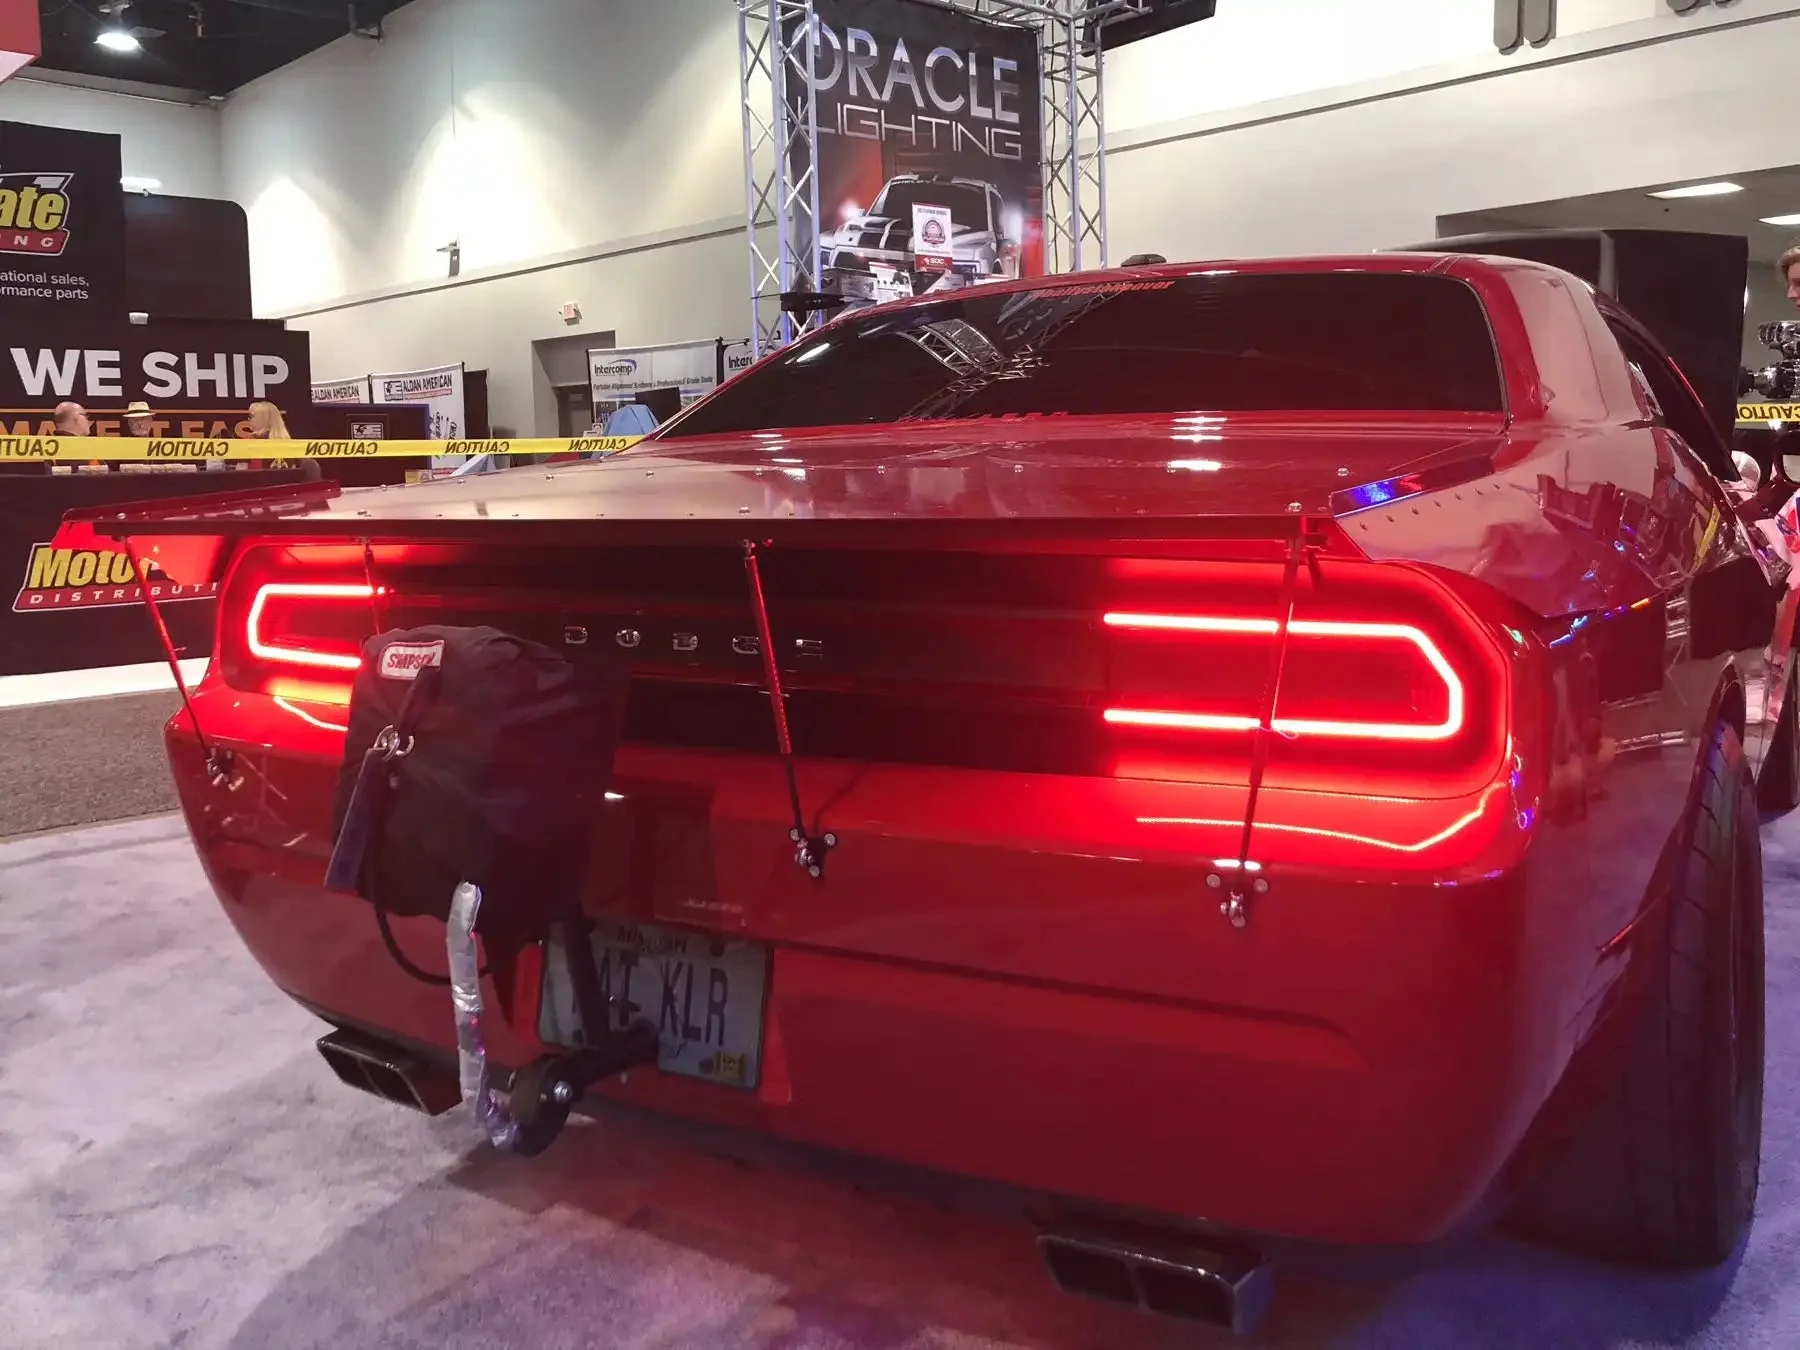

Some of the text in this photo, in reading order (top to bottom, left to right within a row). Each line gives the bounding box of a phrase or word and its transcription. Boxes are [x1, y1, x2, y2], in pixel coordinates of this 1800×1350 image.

[791, 20, 1020, 124] ORACLE
[797, 96, 1022, 161] LIGHTING
[0, 234, 54, 247] NG
[0, 270, 89, 287] ational sales,
[55, 288, 89, 301] parts
[9, 347, 290, 399] WE SHIP
[594, 364, 633, 376] Intercomp
[332, 384, 360, 398] AMERICAN
[403, 373, 453, 393] ALDAN AMERICAN
[29, 582, 218, 605] DISTRIBUTI
[564, 625, 824, 659] DODGE
[659, 957, 728, 1047] KLR
